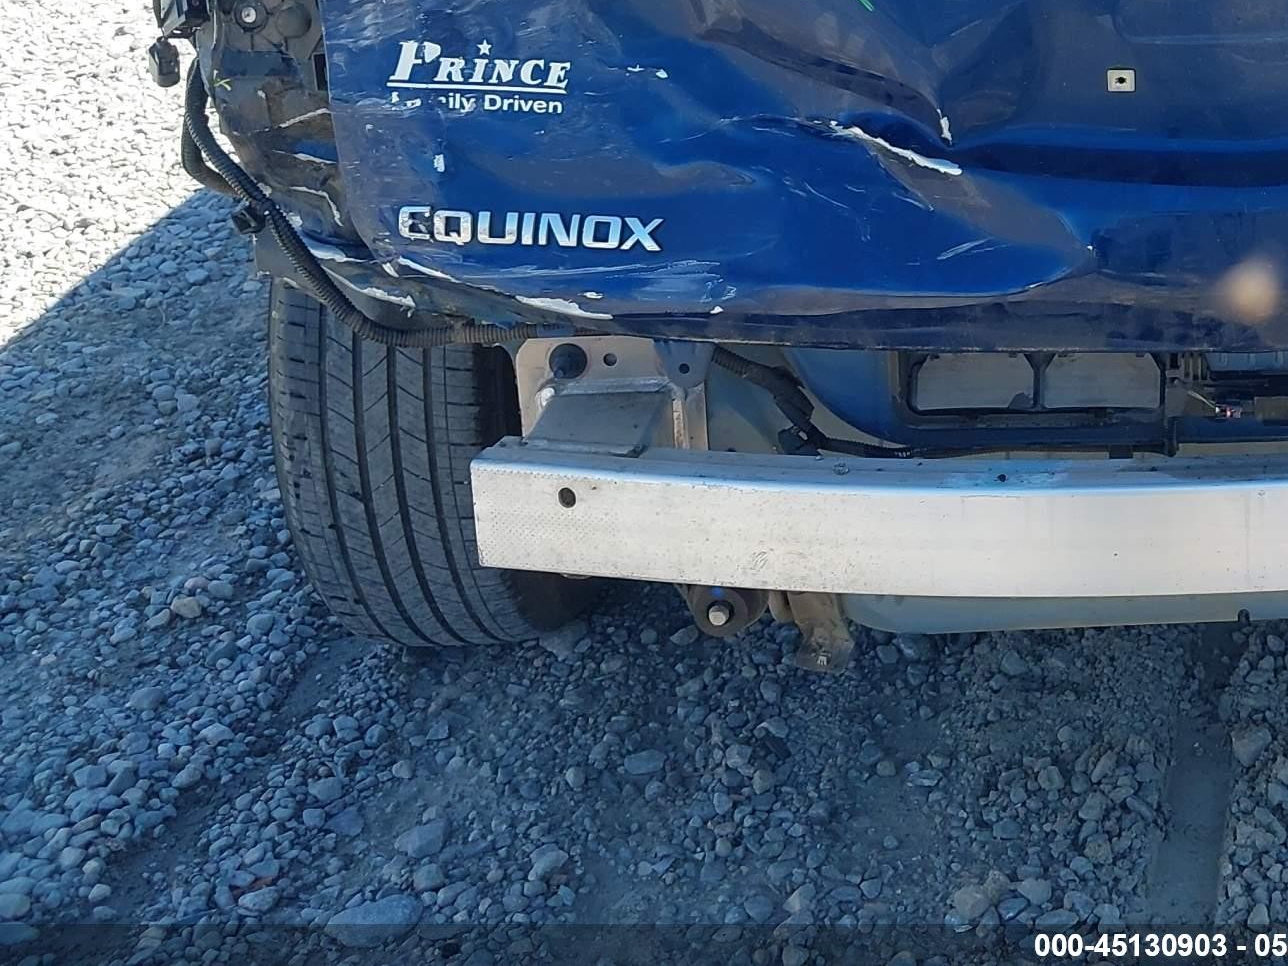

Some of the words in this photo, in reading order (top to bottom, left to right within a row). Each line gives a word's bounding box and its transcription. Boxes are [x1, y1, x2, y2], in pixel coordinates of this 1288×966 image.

[388, 40, 571, 89] PRINCE
[484, 94, 563, 114] Driven
[398, 205, 664, 252] EQUINOX
